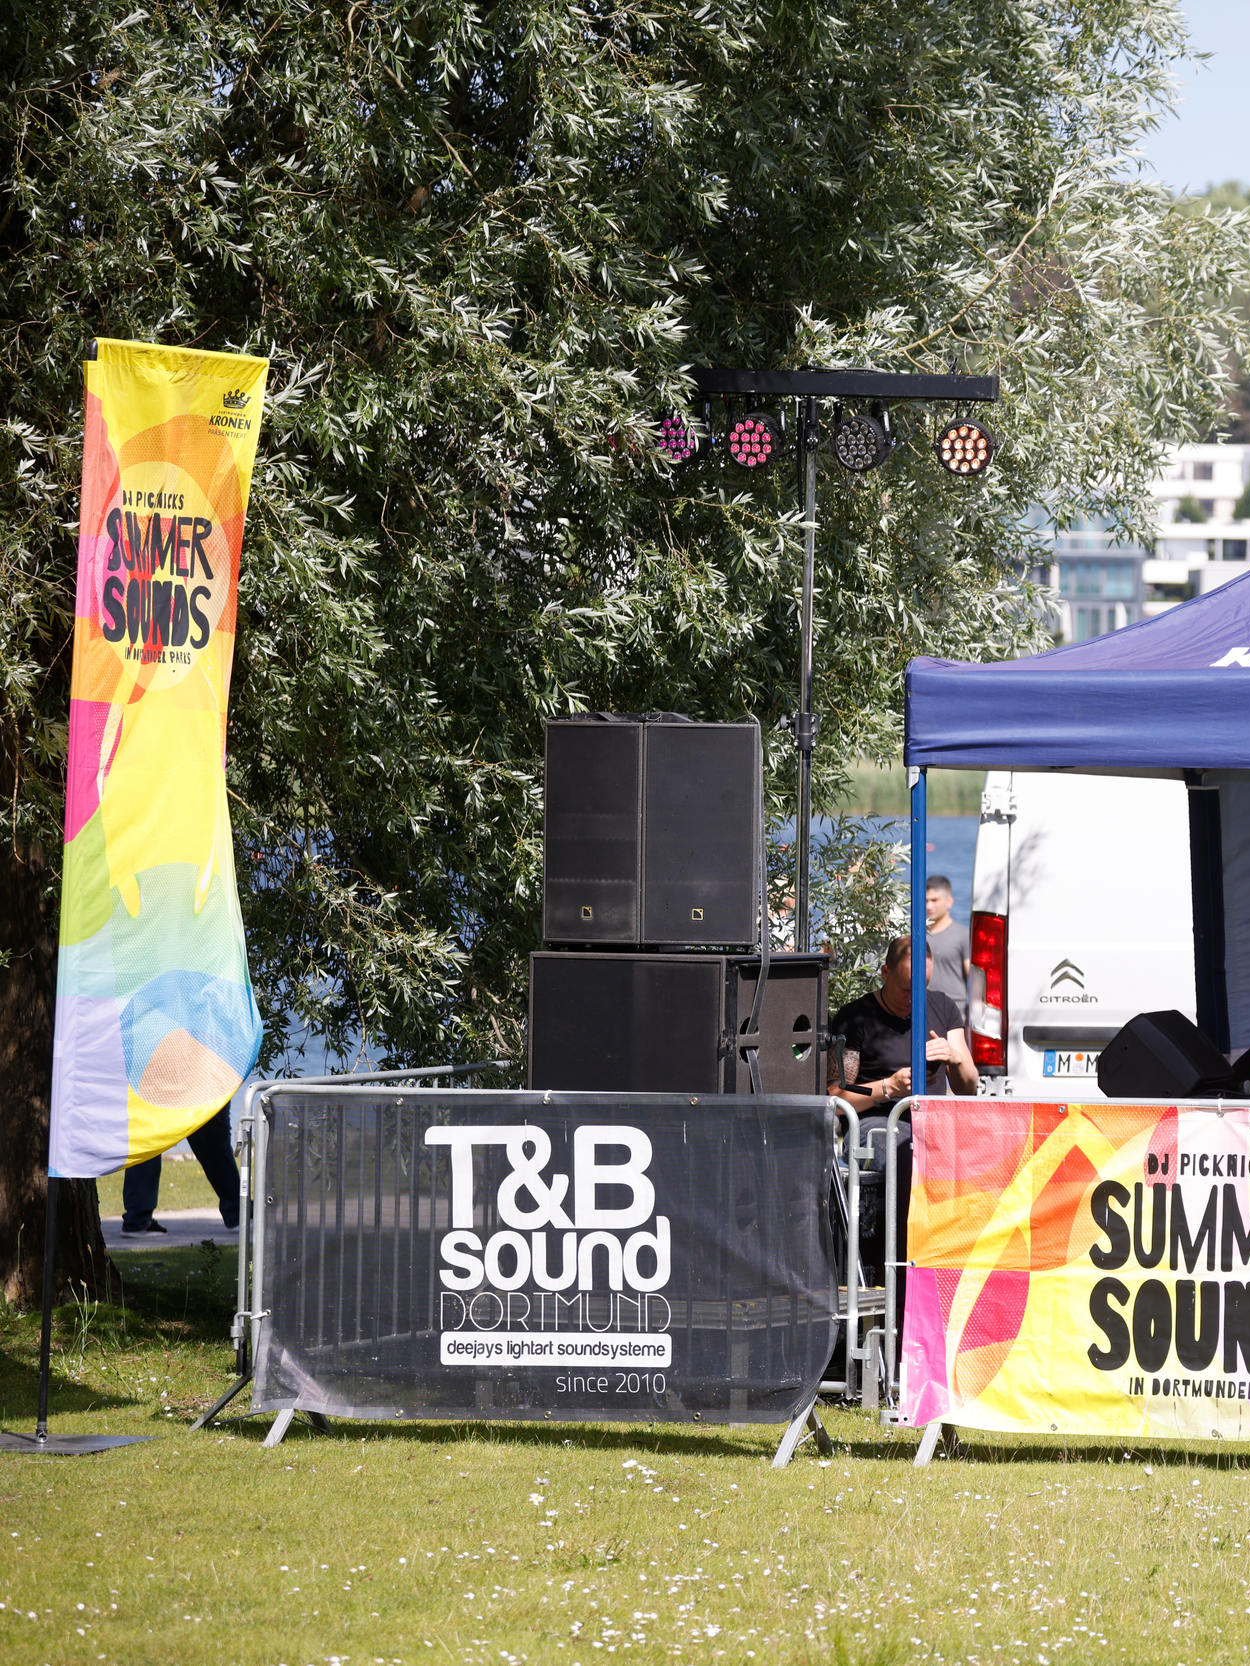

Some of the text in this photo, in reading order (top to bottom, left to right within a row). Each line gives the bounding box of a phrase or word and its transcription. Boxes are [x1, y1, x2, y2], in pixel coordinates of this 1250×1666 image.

[209, 415, 252, 430] KRONEN
[123, 490, 132, 506] DJ
[107, 508, 214, 579] SUMMER
[103, 576, 212, 649] SOUNDS
[169, 651, 191, 665] PARKS
[1148, 1153, 1169, 1175] DJ
[424, 1125, 656, 1229] T&B
[440, 1216, 670, 1291] sound
[440, 1292, 671, 1332] DORTMUND
[447, 1340, 665, 1360] deejays lightart soundsysteme
[556, 1371, 666, 1394] since 2010
[1129, 1377, 1144, 1395] IN
